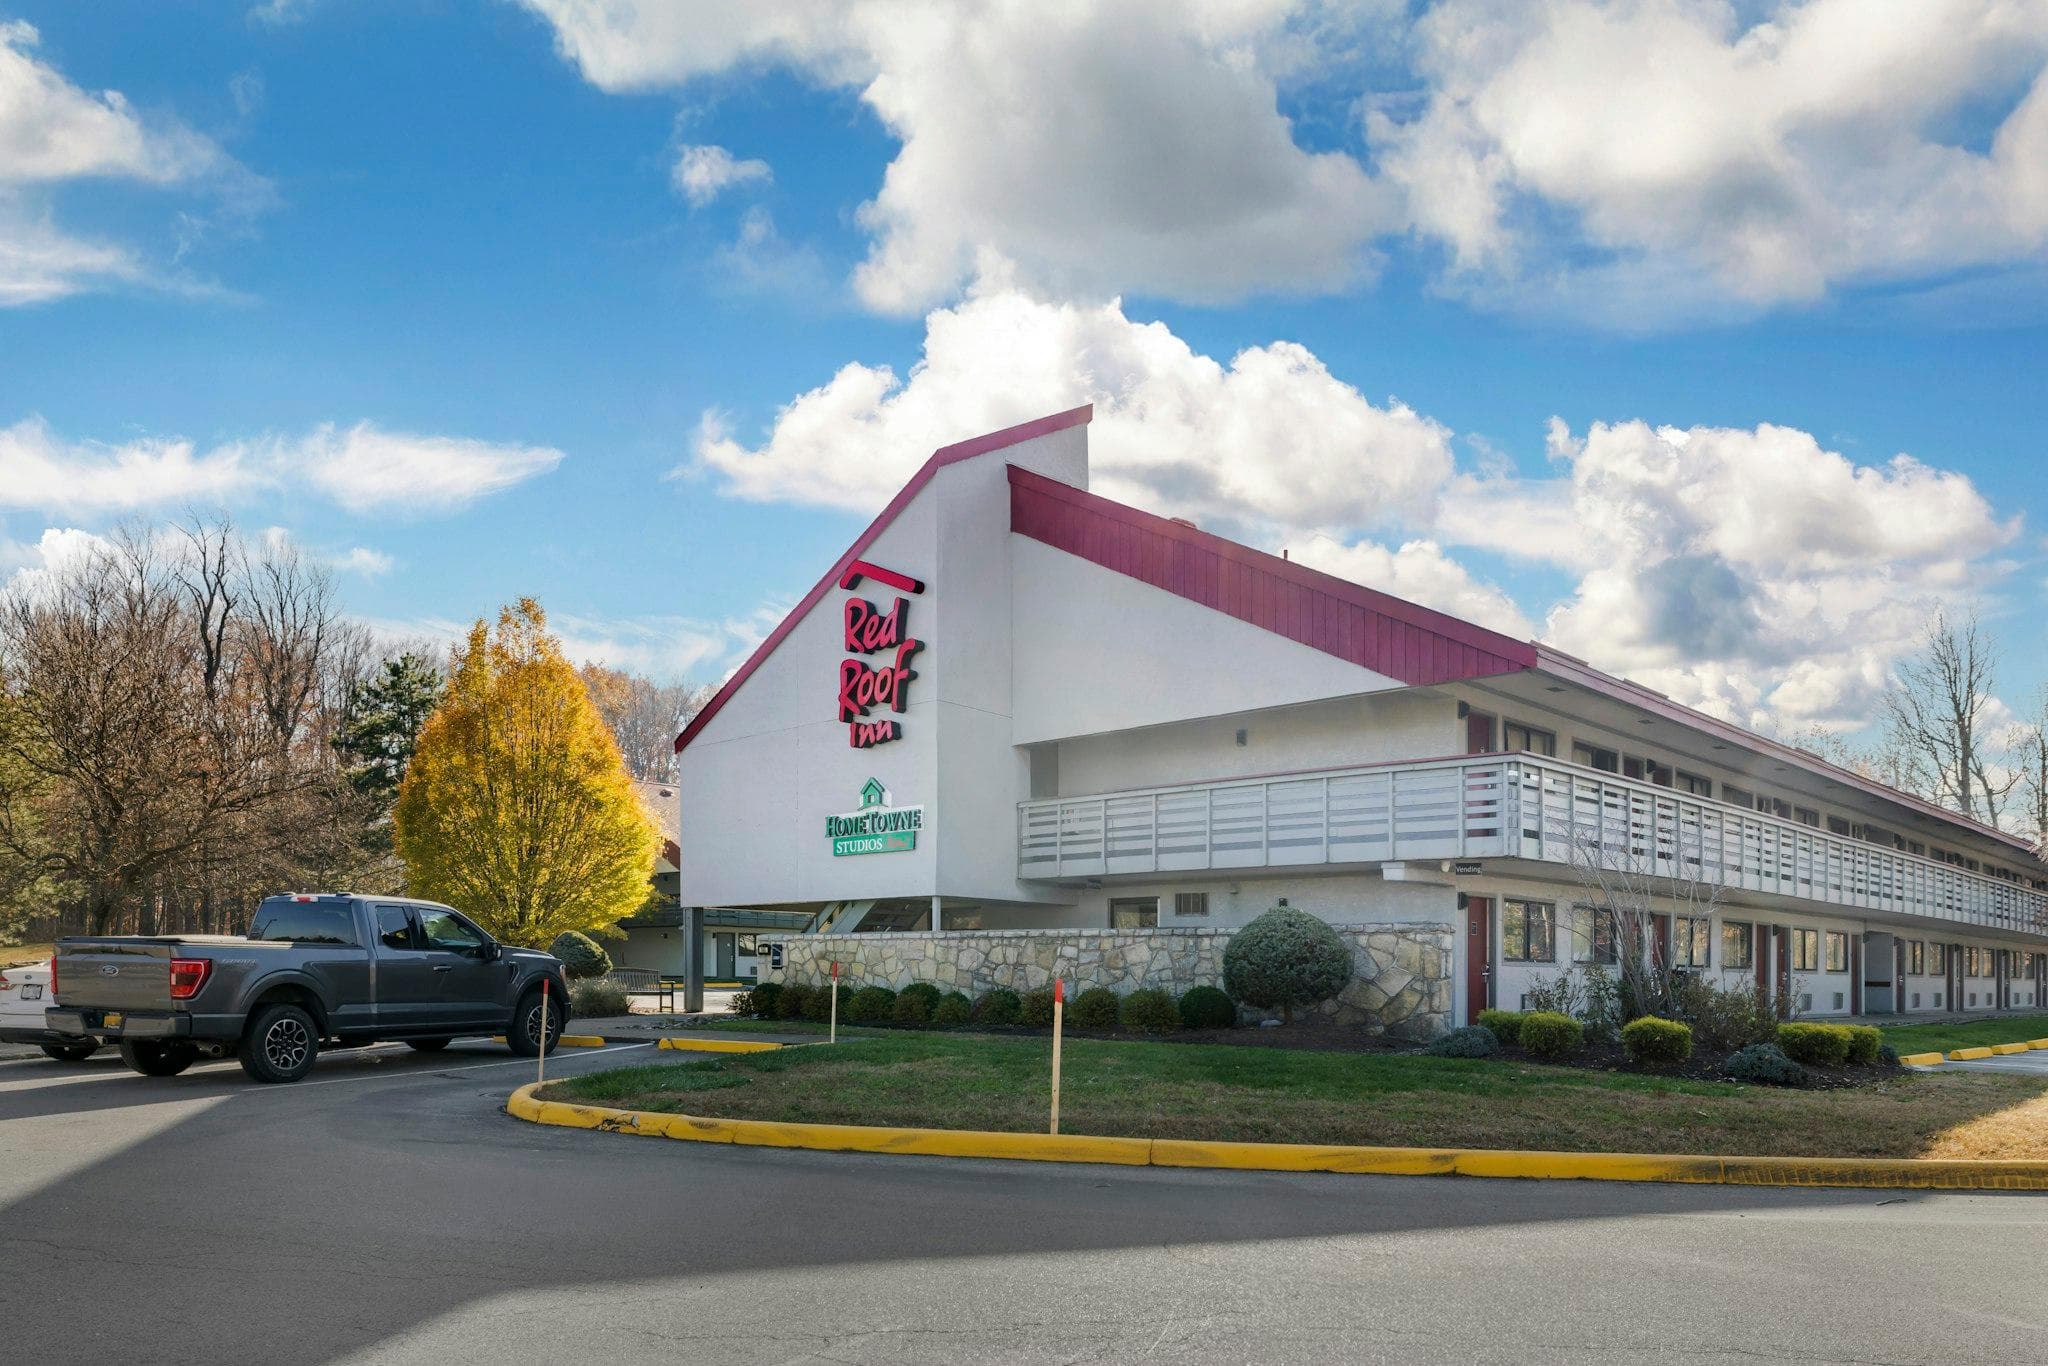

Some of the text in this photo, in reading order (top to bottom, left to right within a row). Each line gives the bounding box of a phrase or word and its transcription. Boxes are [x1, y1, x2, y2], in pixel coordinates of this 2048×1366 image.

[844, 597, 908, 653] Red
[839, 638, 922, 722] Roof
[836, 838, 883, 853] STUDIOS
[1456, 865, 1481, 874] Vending
